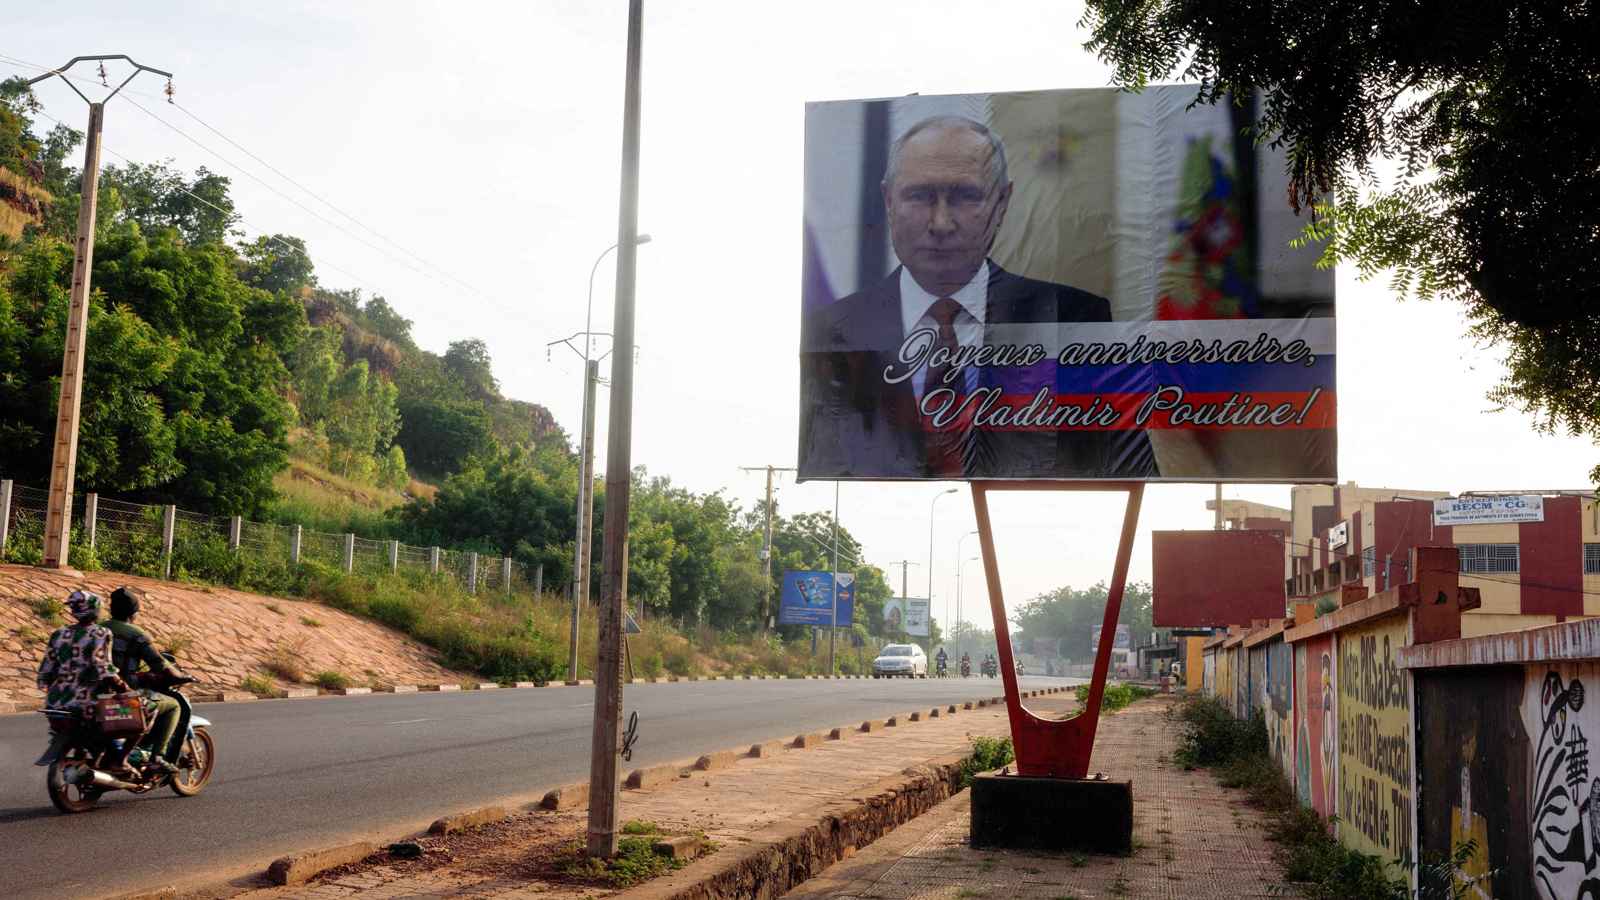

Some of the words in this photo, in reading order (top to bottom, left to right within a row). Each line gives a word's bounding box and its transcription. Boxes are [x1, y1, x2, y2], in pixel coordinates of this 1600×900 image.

[883, 328, 1046, 383] Joyeux
[1058, 332, 1316, 369] anniversaire,
[920, 385, 1122, 428] Vladimir
[1135, 383, 1321, 428] Poutine!
[1452, 502, 1492, 511] BECM
[1505, 500, 1526, 508] CG
[1343, 640, 1359, 702] Notre
[1384, 634, 1409, 710] Besoi
[1362, 776, 1379, 848] BIEN
[1380, 781, 1390, 849] de
